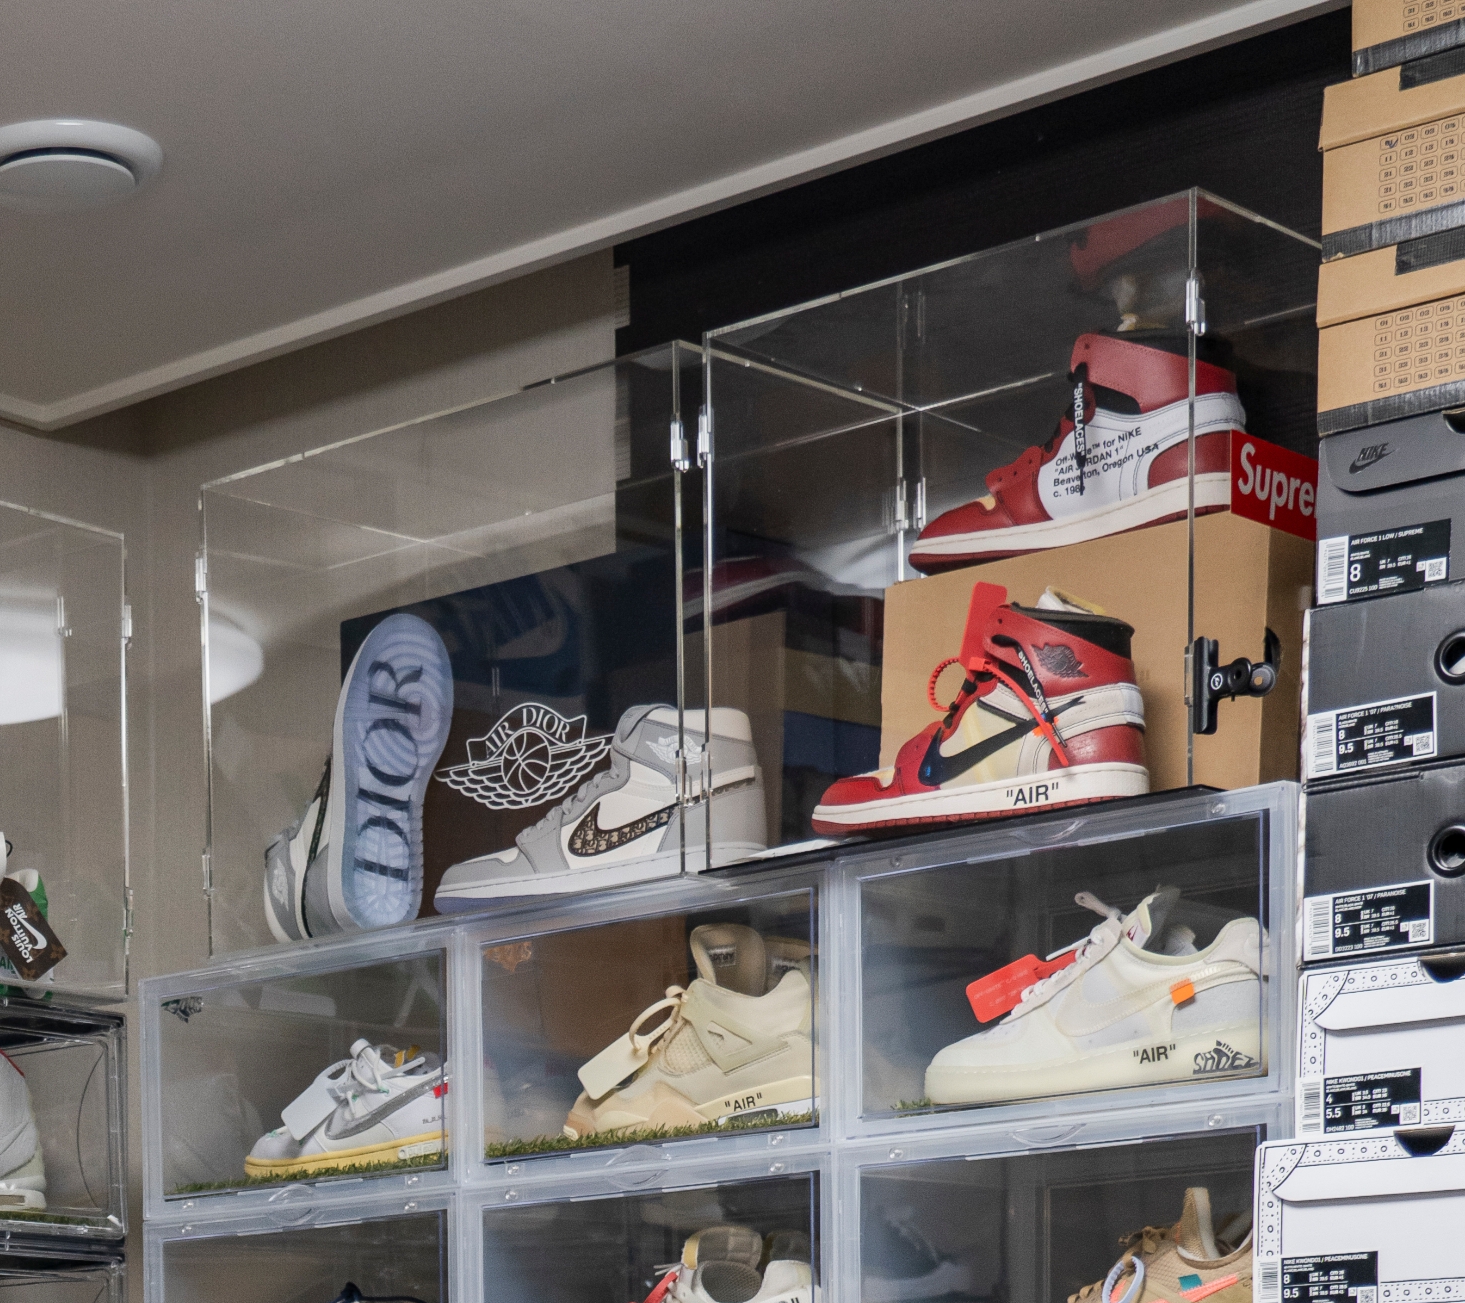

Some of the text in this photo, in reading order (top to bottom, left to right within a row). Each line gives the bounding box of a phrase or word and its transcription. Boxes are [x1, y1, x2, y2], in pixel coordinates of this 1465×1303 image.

[1103, 440, 1115, 449] for
[1118, 427, 1142, 443] NIKE
[1357, 443, 1390, 463] NIKE
[1053, 443, 1159, 487] Beaveton, Oregon USA
[1238, 442, 1318, 520] Supre
[1360, 535, 1378, 545] FORCE
[1382, 533, 1395, 541] LOW
[1398, 527, 1424, 538] SUPREME
[1349, 563, 1361, 582] 8
[484, 705, 571, 758] AIR DIOR
[1338, 729, 1345, 740] 8
[1338, 743, 1354, 754] 9.5
[354, 659, 424, 883] DIOR
[1006, 781, 1059, 807] "AIR"
[12, 903, 29, 921] AIR
[1335, 913, 1342, 924] 8
[4, 907, 33, 952] VUITTON
[1335, 927, 1350, 938] 9.5
[12, 933, 34, 964] LOUIS
[1132, 1041, 1177, 1067] "AIR"
[724, 1092, 763, 1113] "AIR"
[1325, 1093, 1333, 1104] 4
[1325, 1108, 1342, 1119] 5.5
[1283, 1274, 1291, 1285] 8
[1283, 1288, 1299, 1299] 9.5
